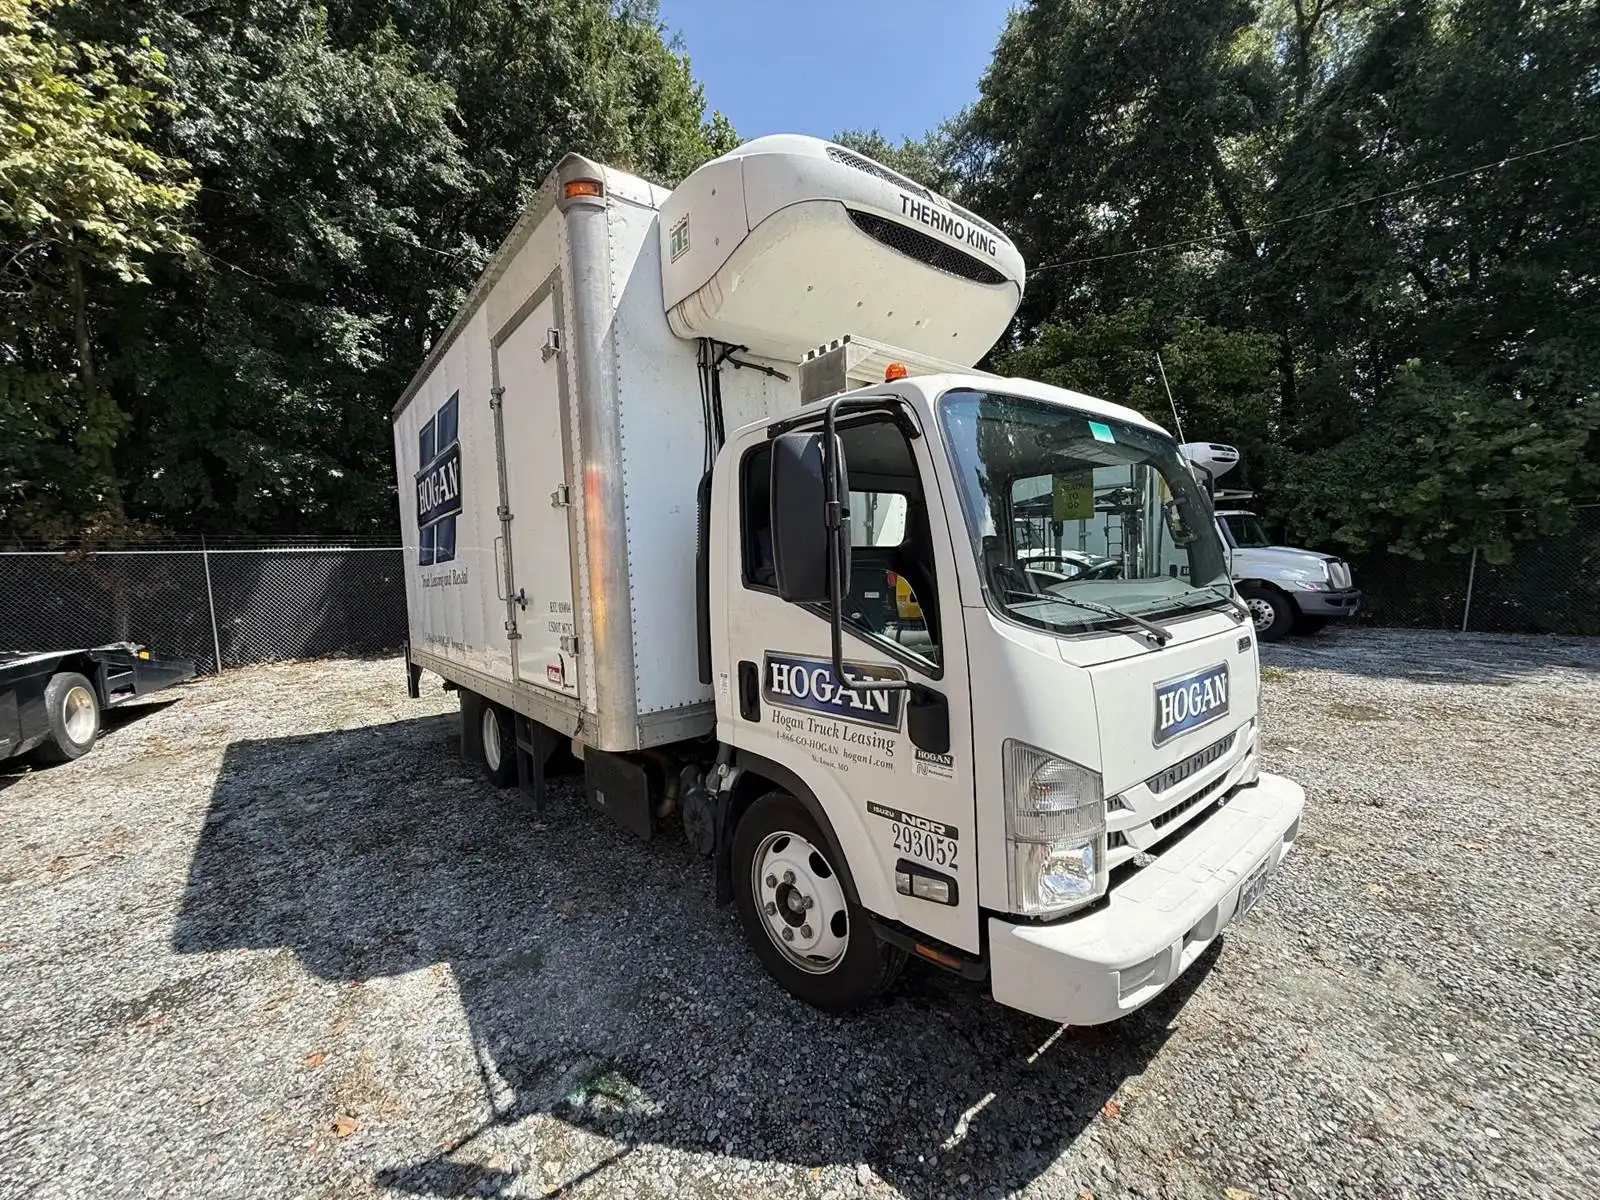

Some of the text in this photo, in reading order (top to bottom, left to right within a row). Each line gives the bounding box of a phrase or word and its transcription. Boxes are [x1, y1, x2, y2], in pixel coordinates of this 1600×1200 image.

[900, 193, 997, 257] THERMO KING
[418, 456, 459, 516] HOGAN
[1159, 672, 1227, 731] HOGAN
[771, 709, 896, 757] Hogan Truck Leasing
[776, 730, 839, 755] 1-866-GO-HOGAN
[843, 748, 894, 770] hogan1.com
[837, 763, 849, 773] MO
[917, 750, 951, 765] HOGAN
[873, 806, 895, 818] ISUZU
[892, 822, 959, 872] 293052
